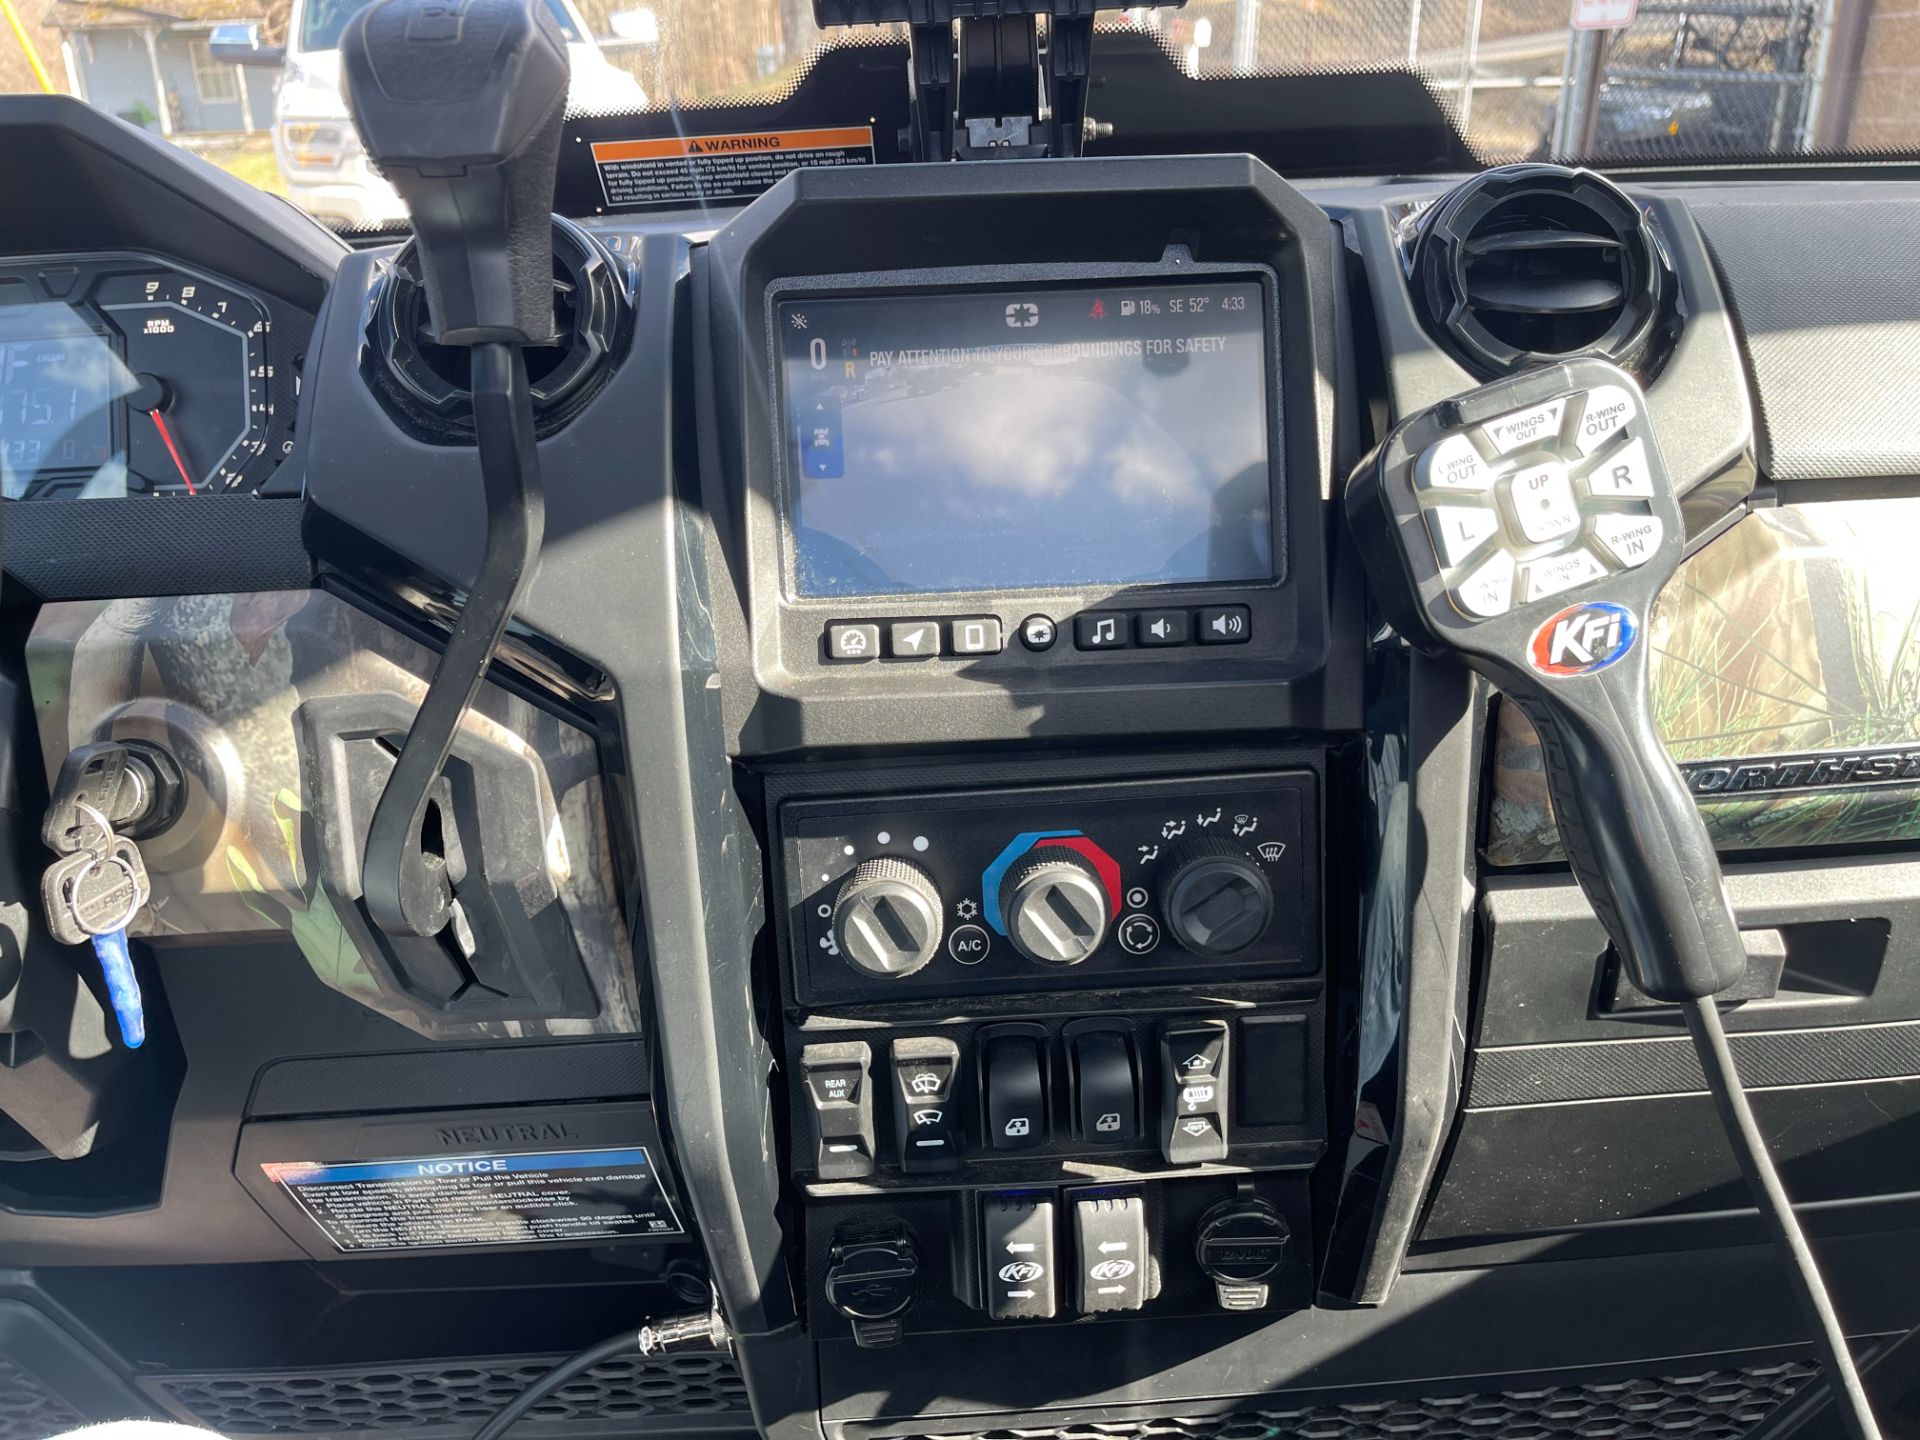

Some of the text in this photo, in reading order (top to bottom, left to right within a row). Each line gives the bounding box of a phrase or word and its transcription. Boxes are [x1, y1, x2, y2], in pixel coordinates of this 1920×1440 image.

[704, 137, 780, 151] WARNING
[620, 161, 655, 170] windshield
[712, 156, 733, 164] tipped
[745, 154, 773, 162] position,
[145, 282, 159, 293] 9
[182, 287, 195, 297] 8
[217, 302, 227, 313] 7
[1139, 300, 1160, 314] 18%
[1169, 300, 1183, 312] SE
[1222, 297, 1245, 310] 4:33
[810, 338, 827, 370] 0
[870, 337, 1226, 367] PAY ATTENTION TO YOUR SURROUNDINGS FOR SAFETY
[845, 362, 856, 379] R
[1586, 403, 1626, 423] R-WING
[1506, 414, 1545, 434] WINGS
[1586, 415, 1618, 436] OUT
[1516, 426, 1538, 441] OUT
[1447, 464, 1477, 484] OUT
[1529, 474, 1549, 490] UP
[1611, 465, 1633, 489] R
[1458, 521, 1476, 541] L
[1611, 525, 1652, 545] R-WING
[1626, 539, 1645, 555] IN
[957, 937, 982, 952] A/C
[825, 1079, 846, 1088] REAR
[829, 1090, 845, 1098] AUX
[437, 1122, 579, 1145] NEUTRAL
[418, 1160, 507, 1175] NOTICE
[297, 1183, 352, 1191] Disconnect
[356, 1179, 420, 1188] Transmission
